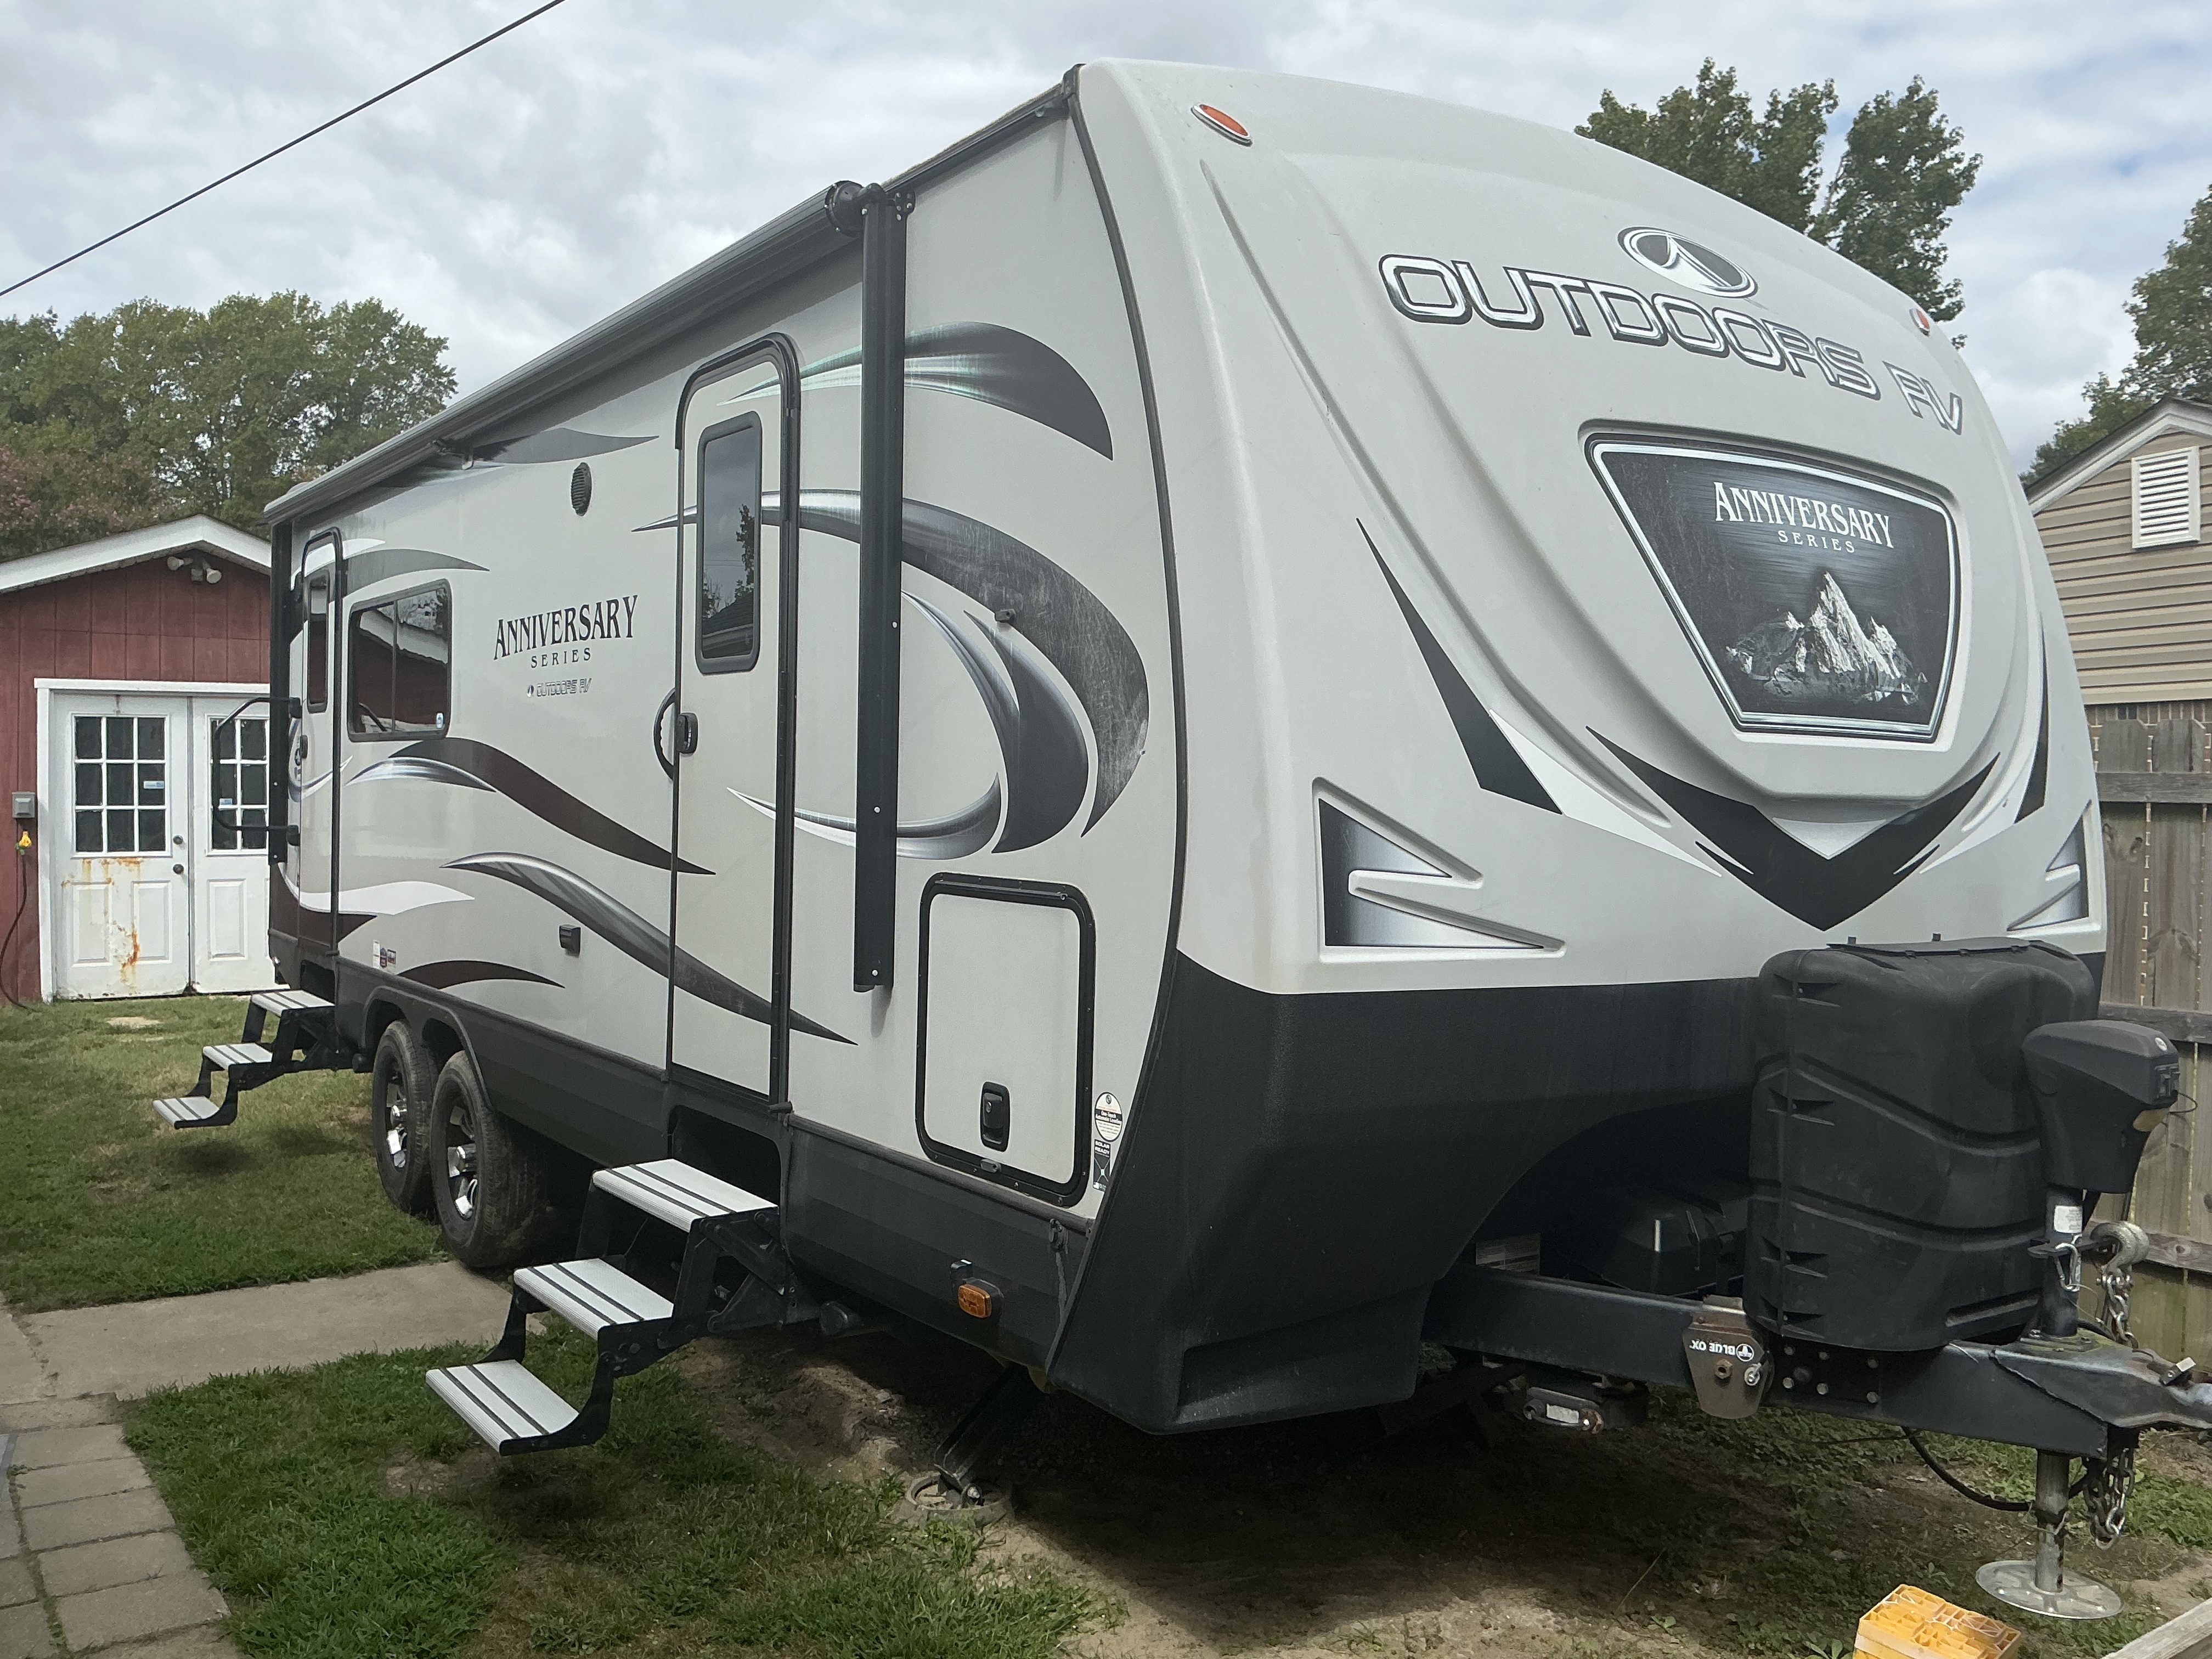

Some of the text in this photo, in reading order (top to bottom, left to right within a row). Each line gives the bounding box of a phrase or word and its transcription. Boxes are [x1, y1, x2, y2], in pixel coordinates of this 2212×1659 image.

[1378, 255, 1963, 436] OUTDOORS RV
[1713, 482, 1894, 549] ANNIVERSARY
[1778, 530, 1855, 553] SERIES
[494, 594, 638, 661] ANNIVERSARY
[531, 647, 591, 669] SERIES
[537, 678, 592, 697] OUTDOORS RV
[1094, 1146, 1110, 1155] READY
[1095, 1141, 1110, 1149] SOLAR
[1709, 1342, 1735, 1356] BLUE
